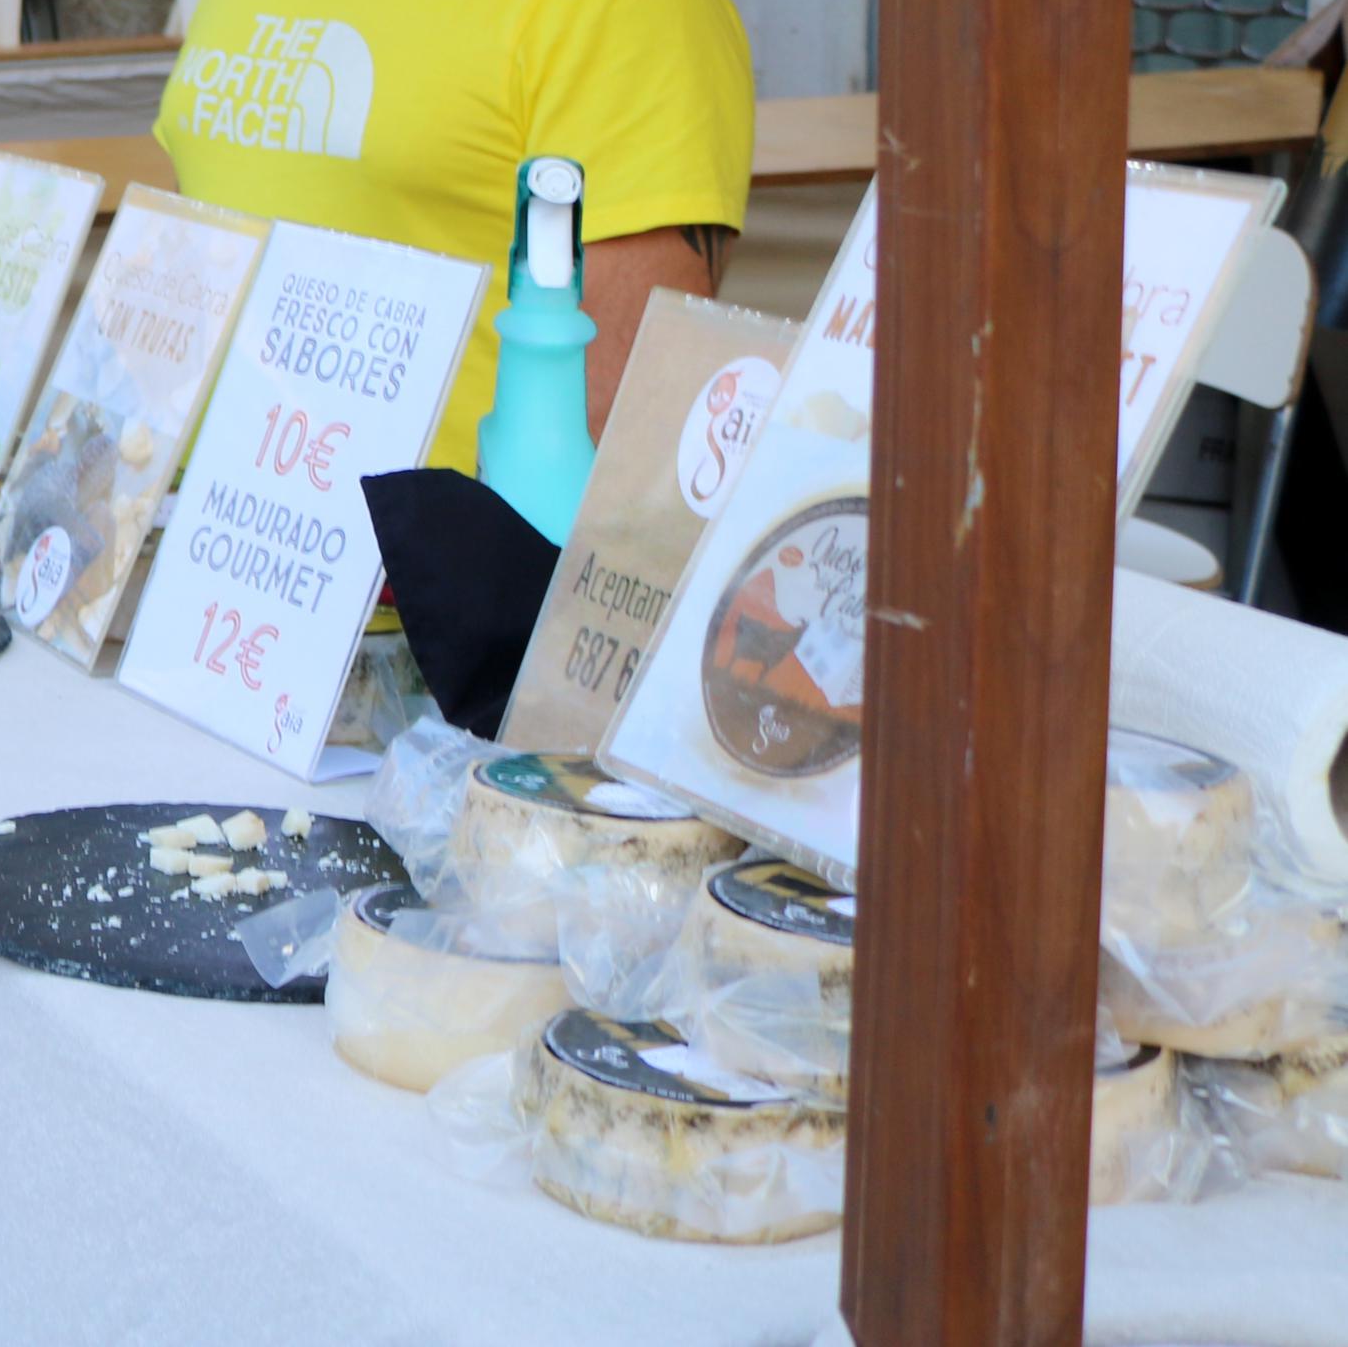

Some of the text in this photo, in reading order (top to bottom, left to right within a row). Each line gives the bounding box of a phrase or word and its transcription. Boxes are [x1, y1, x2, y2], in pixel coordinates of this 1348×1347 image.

[246, 13, 323, 60] THE
[172, 46, 305, 102] NORTH
[192, 92, 288, 150] FACE
[271, 297, 420, 360] FRESCO CON
[282, 272, 427, 330] QUESO DE CABRA
[259, 329, 406, 403] SABORES
[254, 403, 352, 492] 10€
[201, 480, 347, 565] MADURADO
[189, 526, 334, 614] GOURMET
[192, 600, 280, 691] 12€
[565, 625, 620, 693] 687
